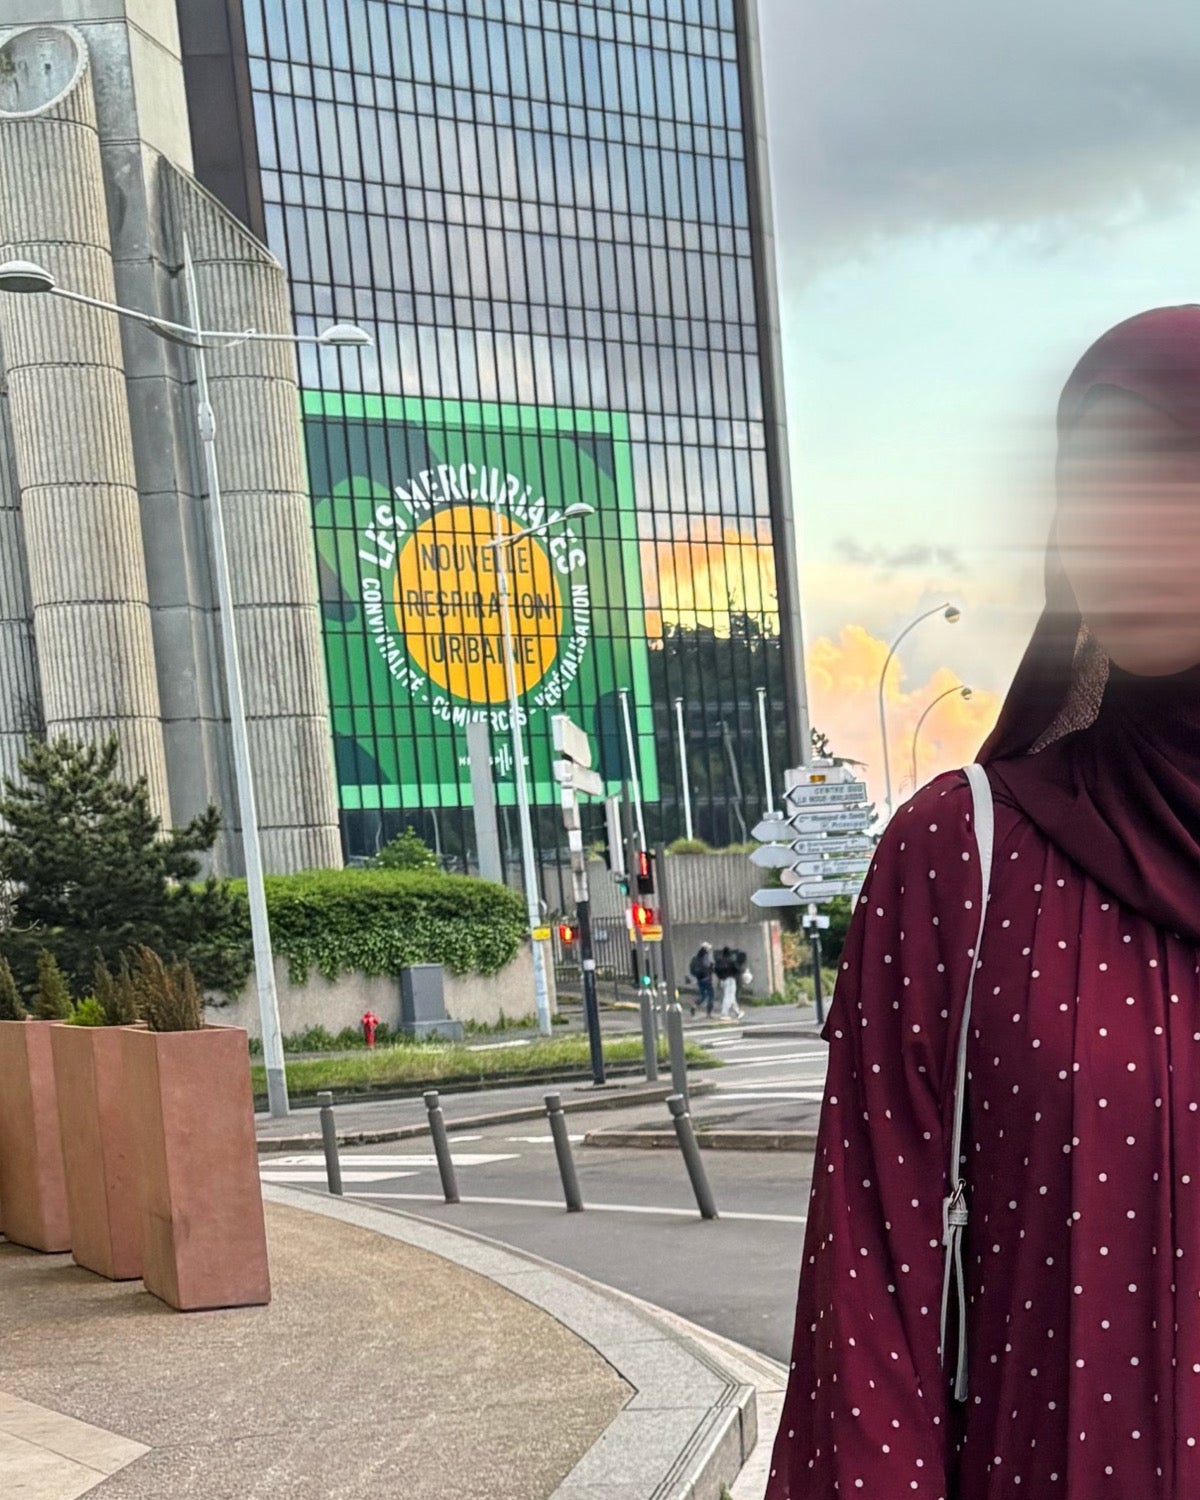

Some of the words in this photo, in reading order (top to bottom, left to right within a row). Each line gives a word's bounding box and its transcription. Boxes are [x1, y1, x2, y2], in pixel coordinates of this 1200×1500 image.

[359, 503, 408, 570] LES
[394, 462, 587, 575] MERCURIALES
[421, 543, 529, 574] NOUVELLE
[406, 589, 551, 620] RESPIRAON
[362, 577, 426, 697] CONVIVIALITÉ
[534, 584, 591, 710] VÉGÉTALISATION
[430, 634, 536, 664] URBAINE
